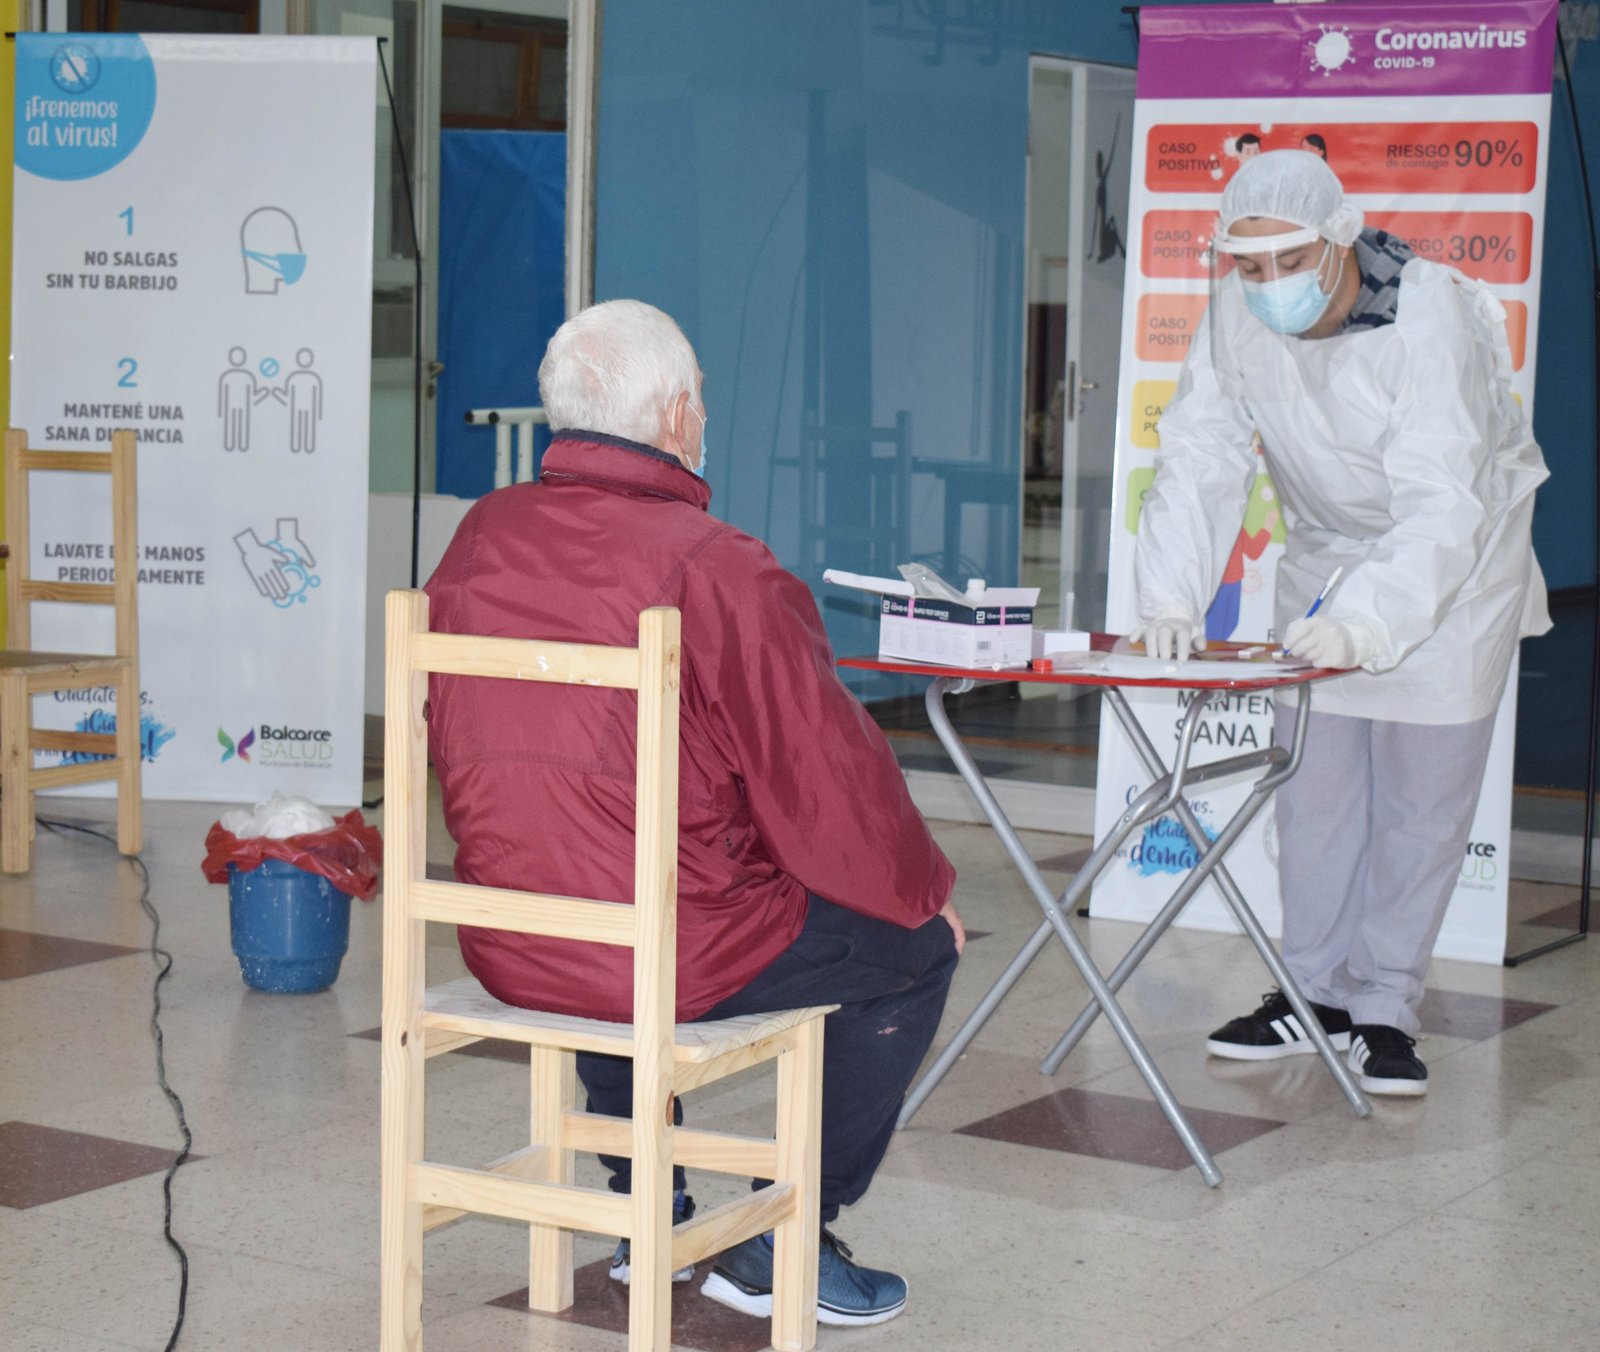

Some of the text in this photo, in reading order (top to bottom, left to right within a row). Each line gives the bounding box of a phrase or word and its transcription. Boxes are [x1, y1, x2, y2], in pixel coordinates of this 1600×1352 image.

[1375, 24, 1527, 50] Coronavirus
[1374, 56, 1436, 69] COVID-19
[25, 95, 118, 121] ¡Frenemos
[27, 121, 117, 147] al virus!
[1158, 142, 1197, 154] CASO
[1386, 139, 1523, 167] RIESGO 90%
[1158, 159, 1220, 170] POSITIVO
[1386, 160, 1398, 168] de
[118, 206, 134, 236] 1
[1154, 230, 1192, 242] CASO
[1448, 235, 1516, 263] 30%
[84, 251, 178, 267] NO SALGAS
[46, 273, 178, 290] SIN TU BARBIJO
[1149, 317, 1187, 329] CASO
[1148, 334, 1192, 345] POSITI
[117, 357, 139, 388] 2
[64, 402, 184, 420] MANTENÉ UNA
[45, 426, 184, 443] SANA DIANCIA
[44, 543, 105, 559] LAVATE
[145, 546, 206, 562] MANOS
[58, 566, 206, 585] PERIODAMENTE
[260, 724, 332, 742] Balcarce
[260, 741, 334, 760] SALUD
